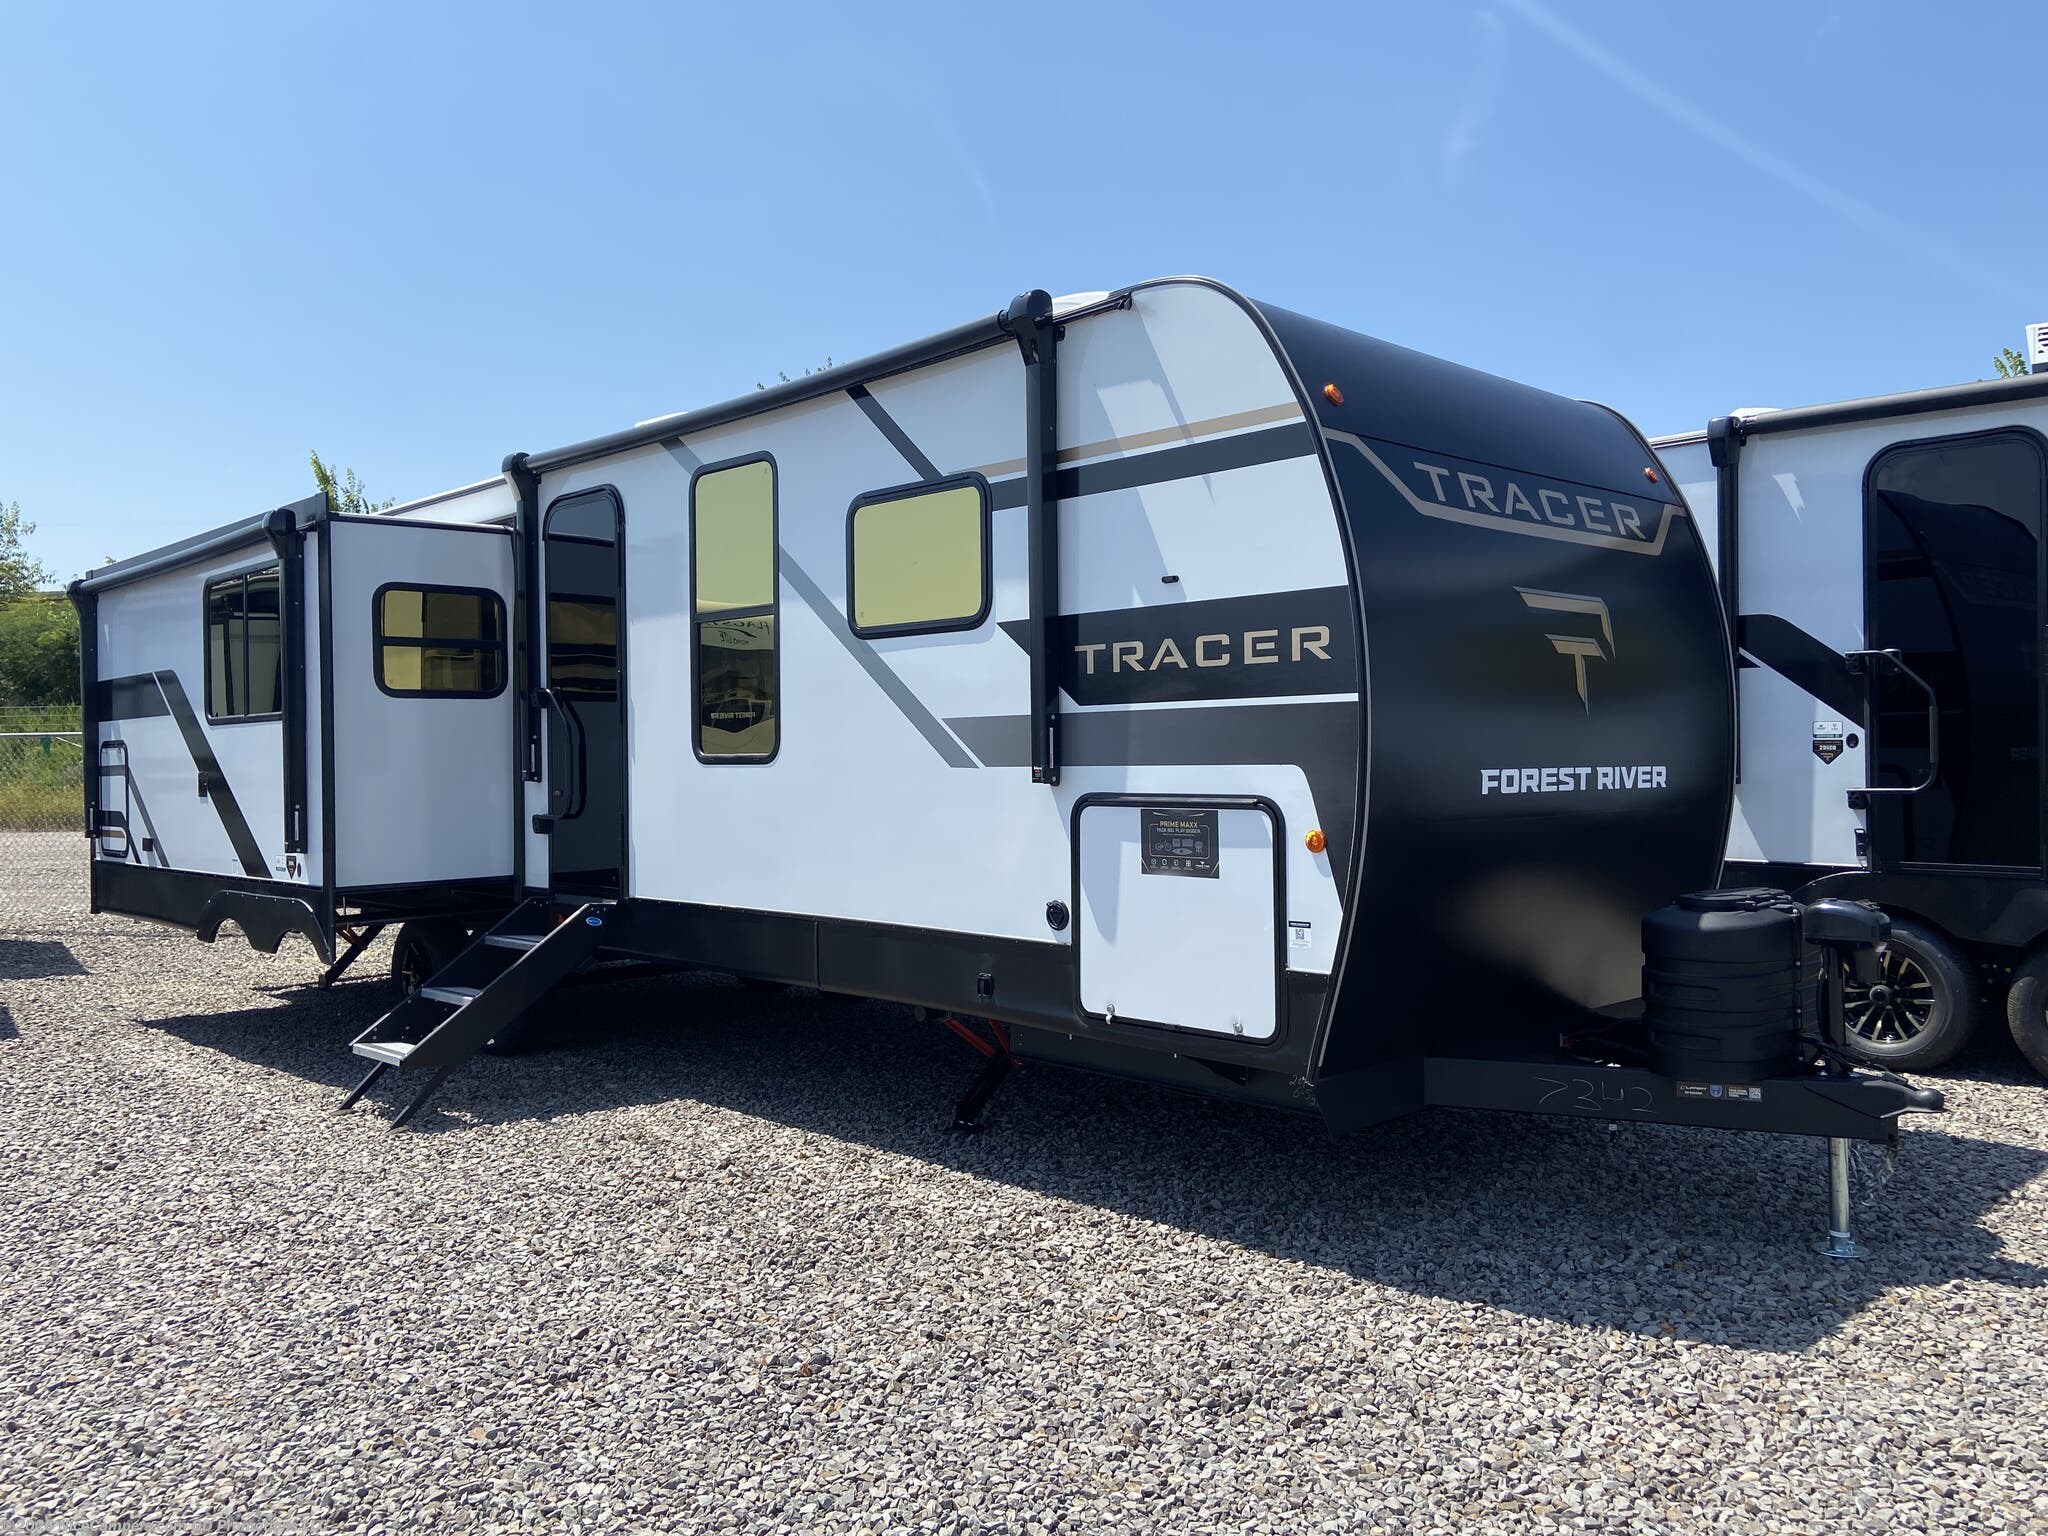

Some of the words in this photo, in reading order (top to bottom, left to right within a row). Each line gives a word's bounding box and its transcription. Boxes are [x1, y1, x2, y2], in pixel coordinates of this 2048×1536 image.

[1413, 461, 1648, 539] TRACER
[1074, 626, 1332, 675] TRACER
[1479, 767, 1592, 795] FOREST
[1596, 765, 1667, 791] RIVER
[1159, 820, 1179, 828] PRIME
[1180, 821, 1198, 829] MAXX
[1534, 1076, 1656, 1116] 7342
